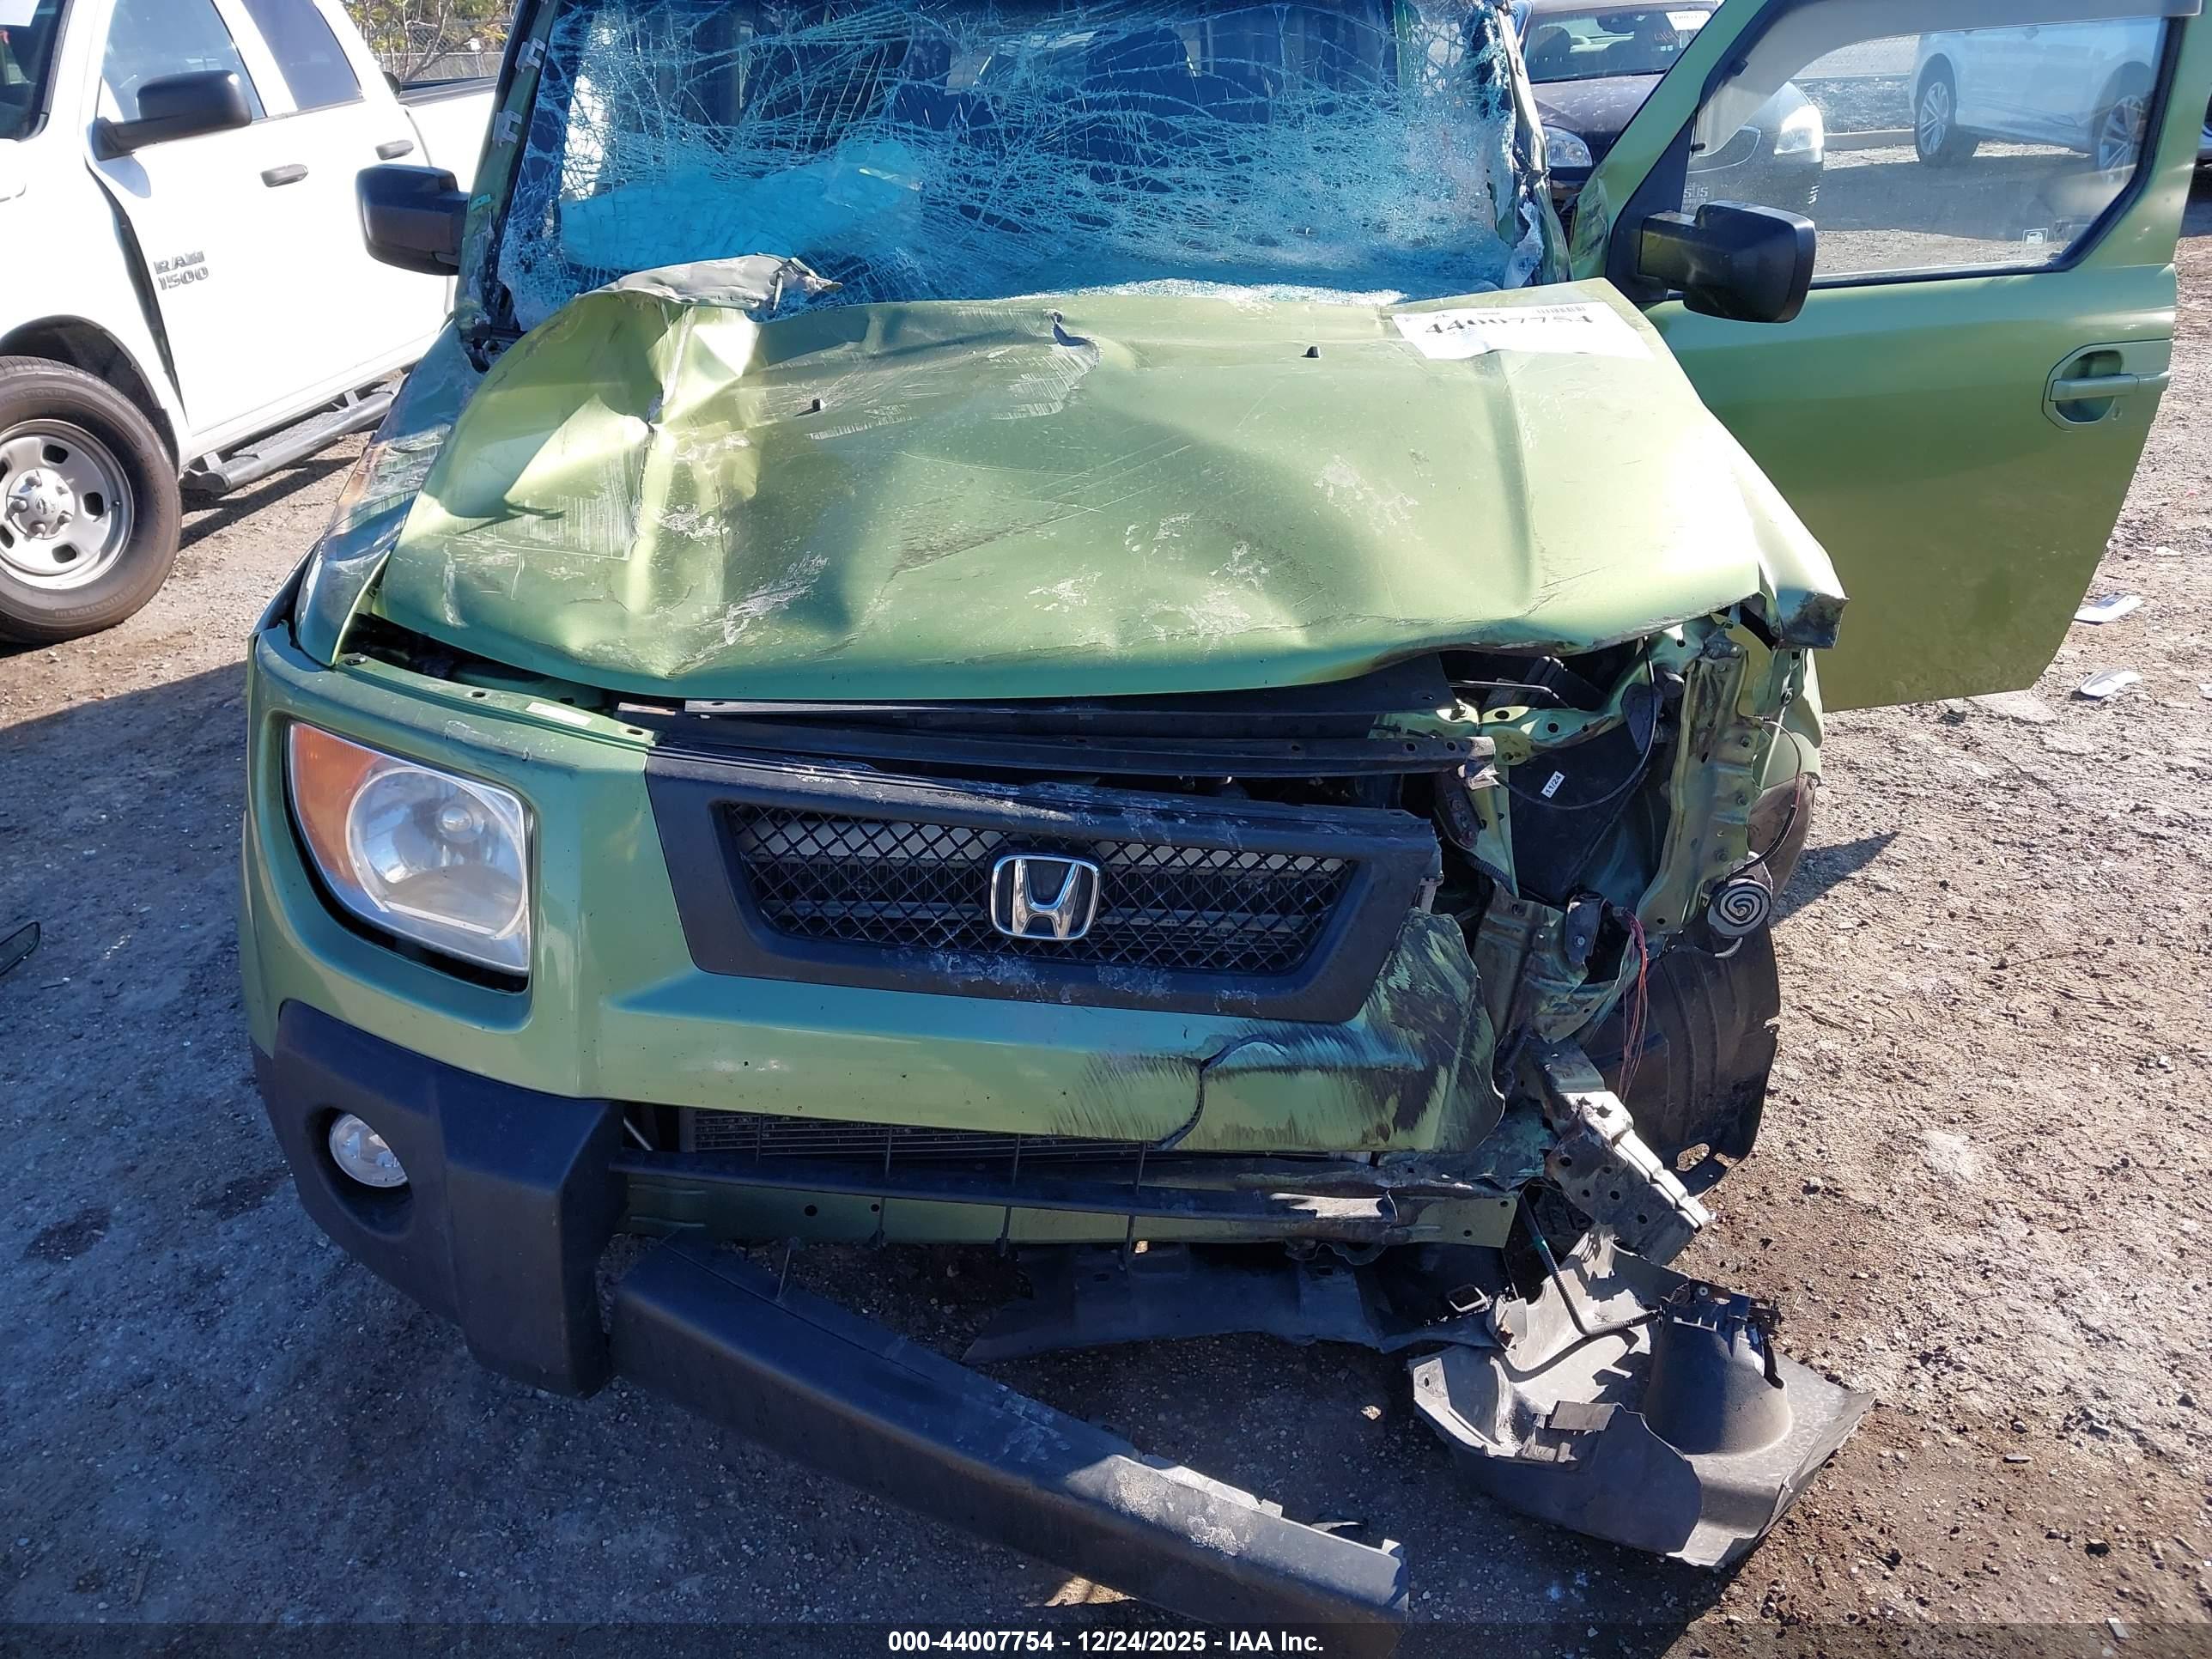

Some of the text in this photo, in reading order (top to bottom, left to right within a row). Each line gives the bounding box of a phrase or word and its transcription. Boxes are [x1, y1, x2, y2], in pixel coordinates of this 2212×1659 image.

[154, 251, 205, 275] RAM
[158, 266, 209, 290] 1500
[1544, 774, 1562, 794] 11/24
